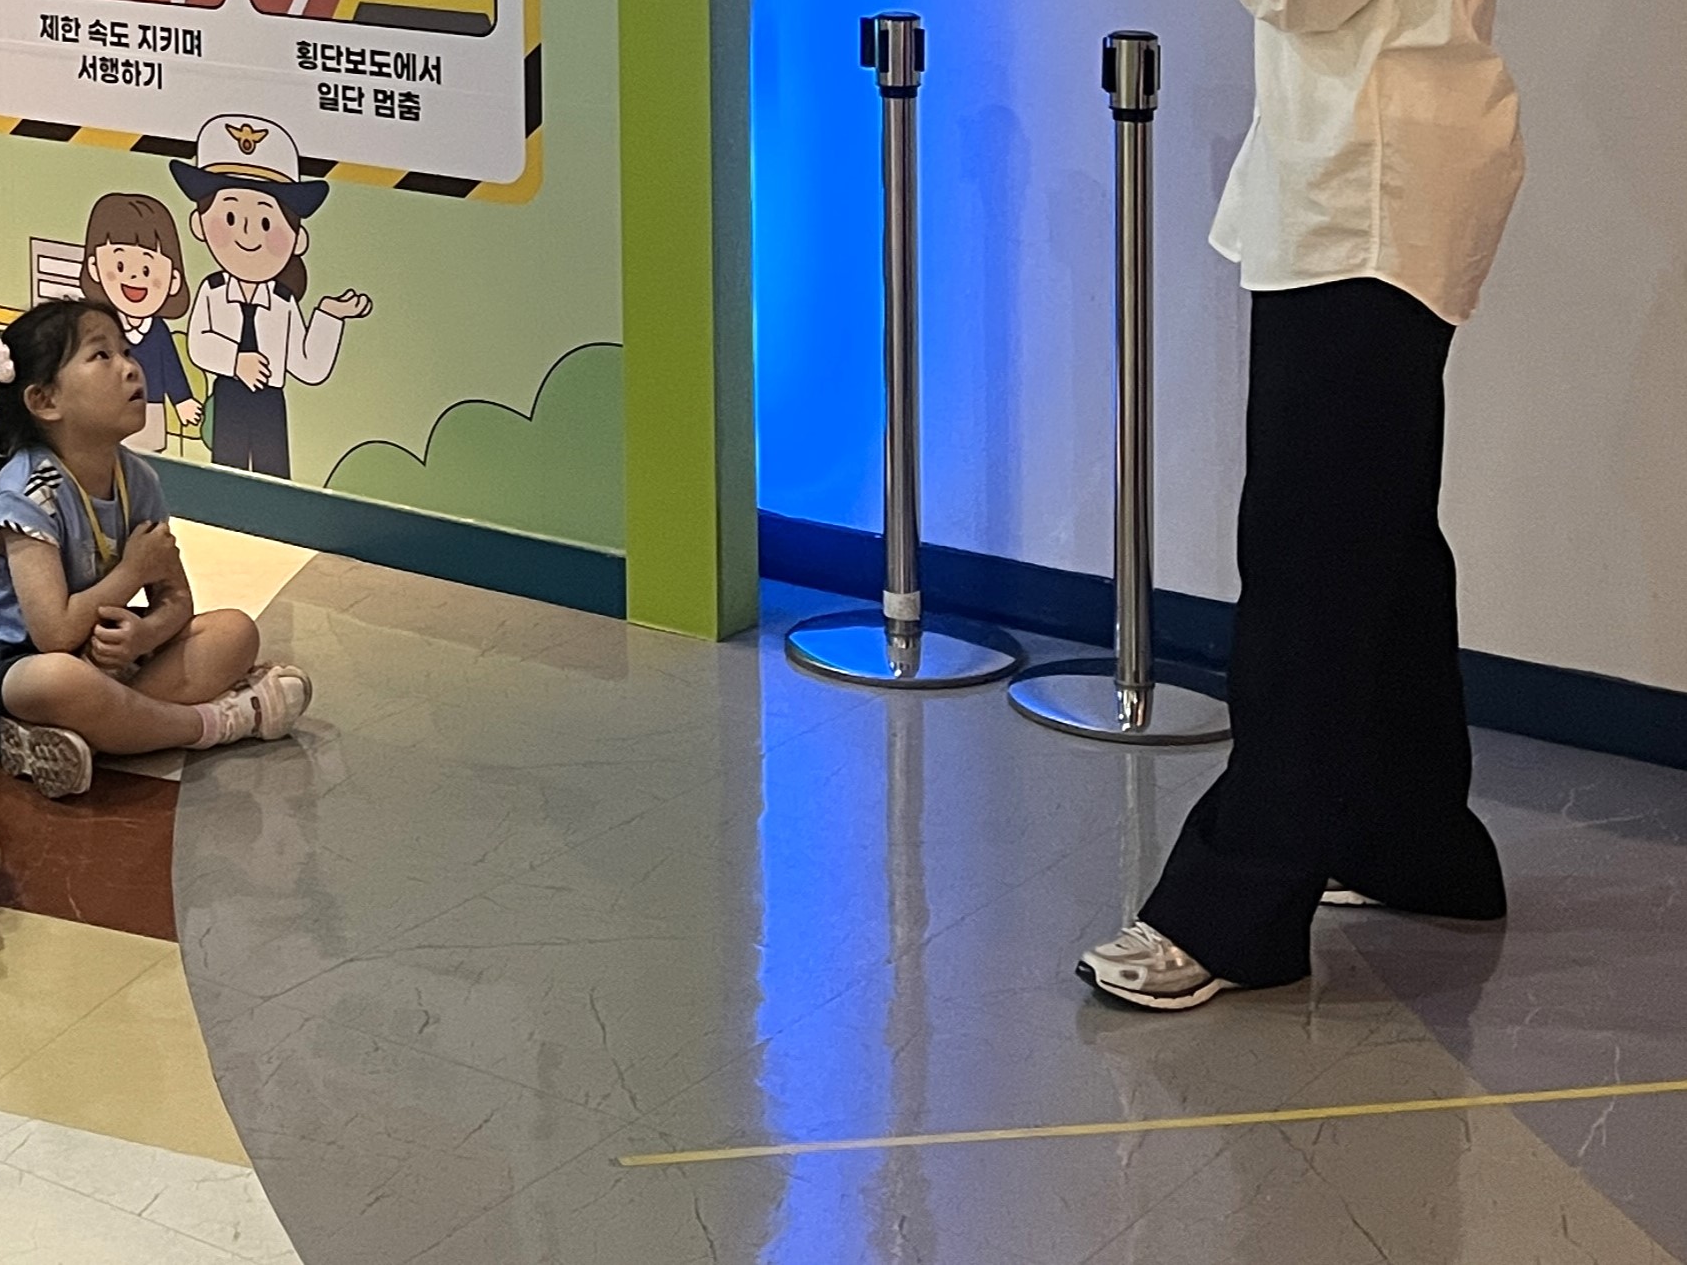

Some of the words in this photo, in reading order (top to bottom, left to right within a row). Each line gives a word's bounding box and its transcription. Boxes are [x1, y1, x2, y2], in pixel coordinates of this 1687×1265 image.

[39, 14, 82, 43] 제한
[88, 18, 131, 49] 속도
[137, 24, 202, 58] 지키며
[77, 54, 163, 90] 서행하기
[296, 40, 442, 86] 횡단보도에서
[317, 82, 365, 115] 일단
[372, 88, 421, 122] 멈춤
